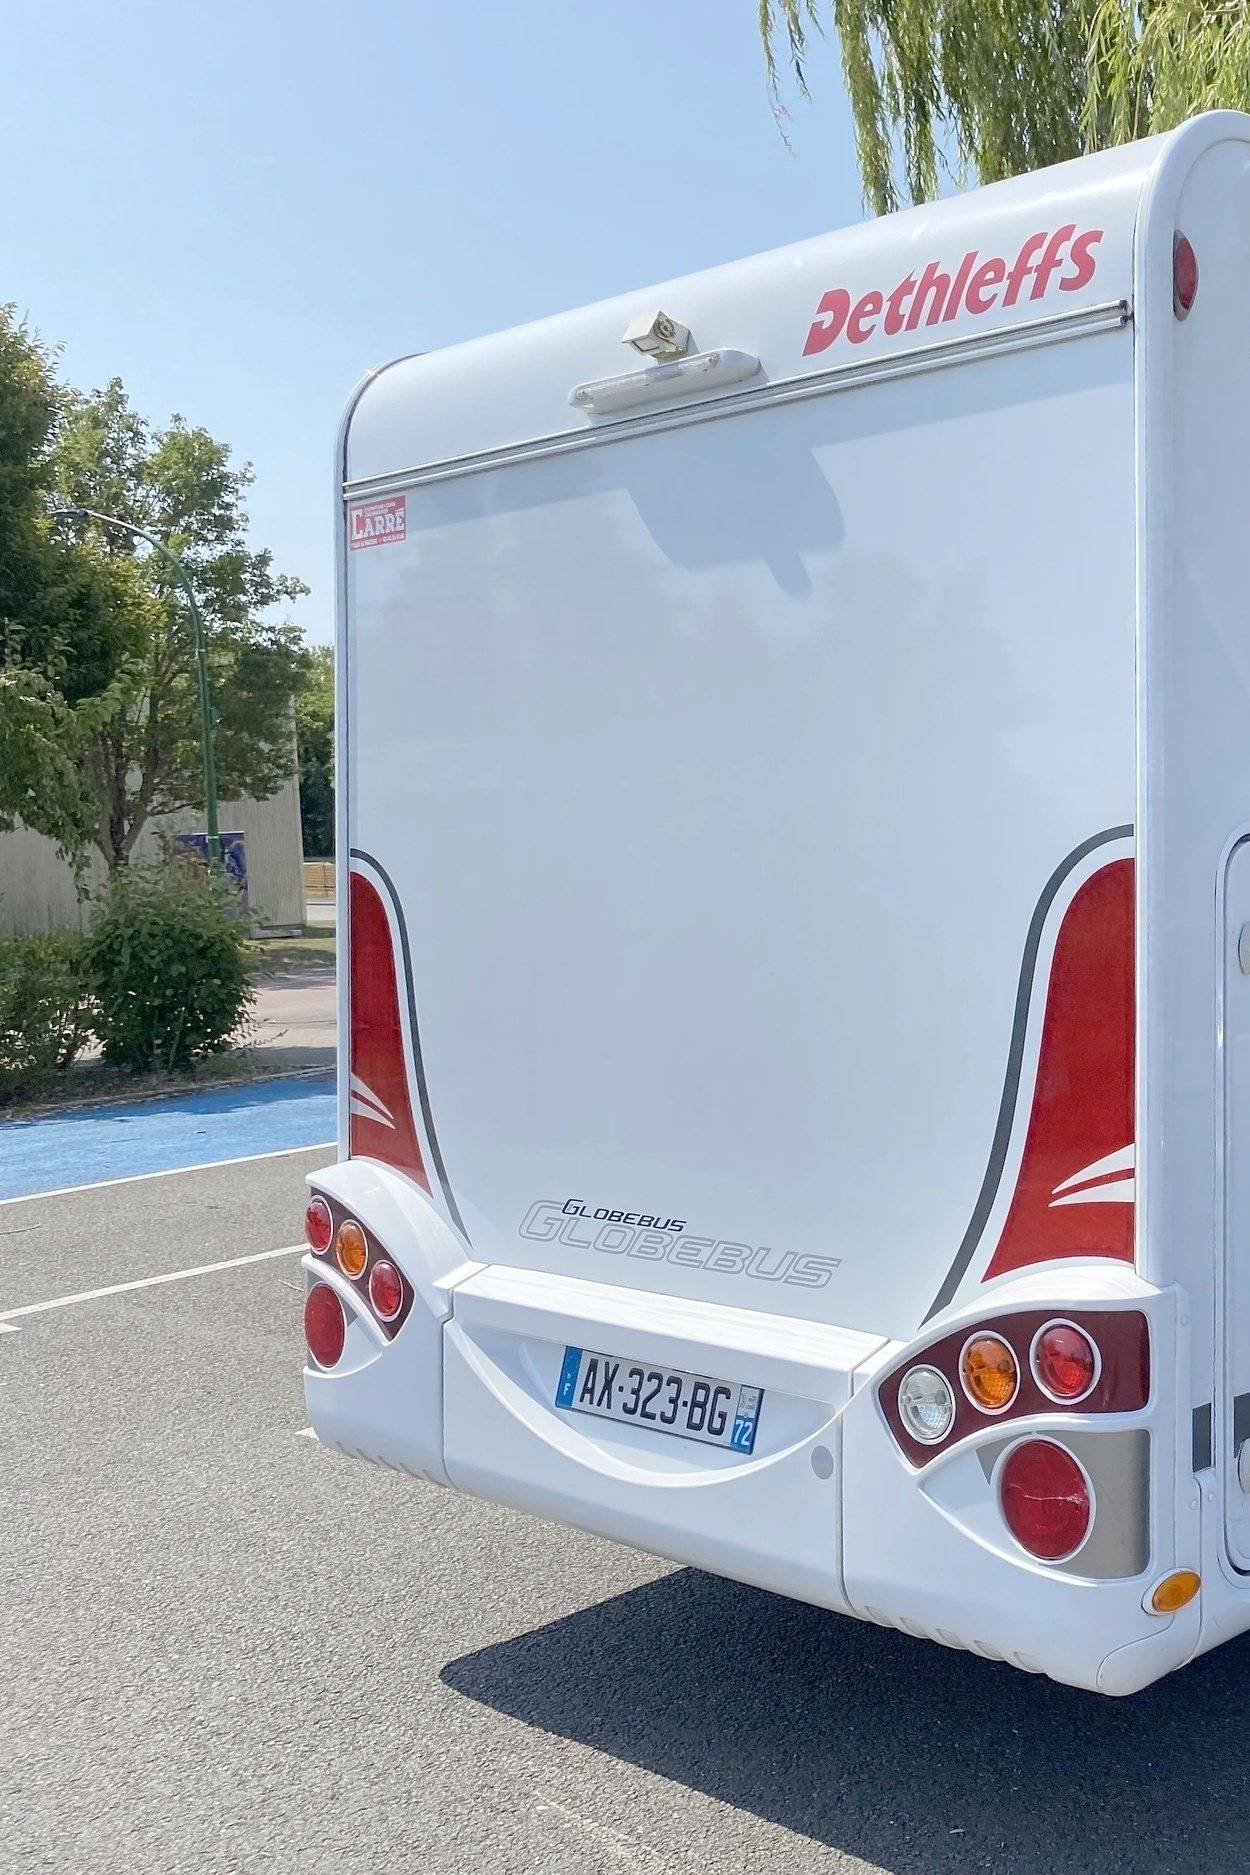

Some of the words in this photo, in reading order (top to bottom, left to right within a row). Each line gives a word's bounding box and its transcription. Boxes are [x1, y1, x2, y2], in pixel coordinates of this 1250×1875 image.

[802, 223, 1104, 357] Dethleffs
[561, 1198, 687, 1232] GLOBEBUS
[518, 1199, 842, 1290] GLOBEBUS
[563, 1382, 571, 1396] F
[734, 1419, 753, 1446] 72
